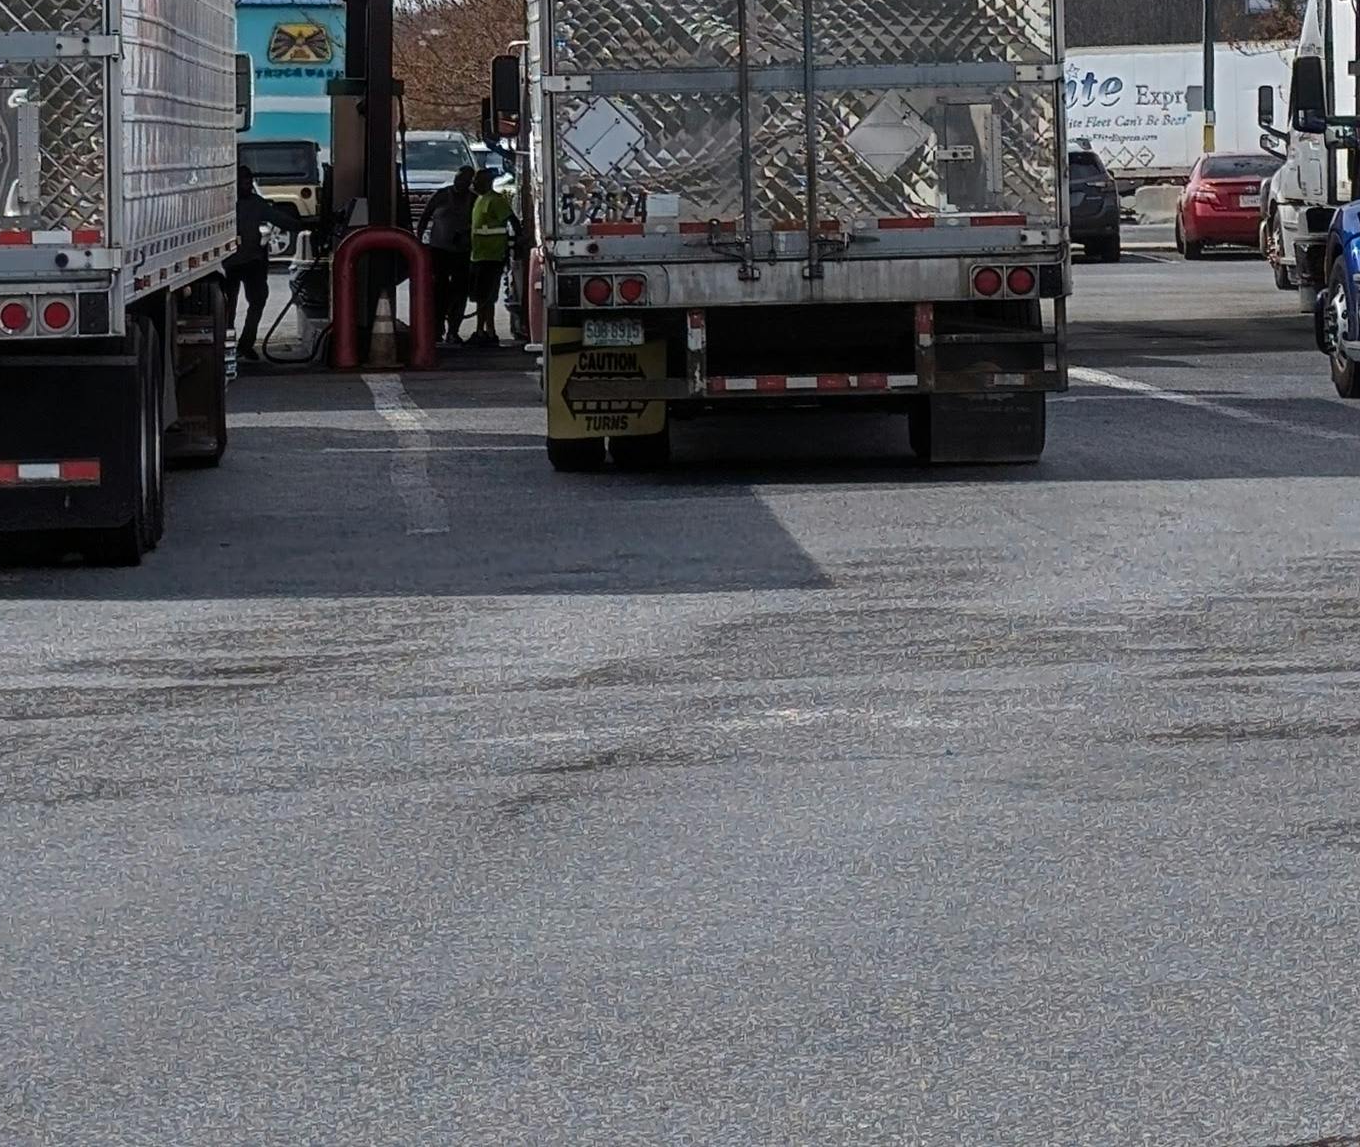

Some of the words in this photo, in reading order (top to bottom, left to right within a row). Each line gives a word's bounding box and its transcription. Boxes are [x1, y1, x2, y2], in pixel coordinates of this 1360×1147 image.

[1135, 85, 1187, 111] Expr
[578, 352, 638, 371] CAUTION
[585, 415, 628, 431] TURNS
